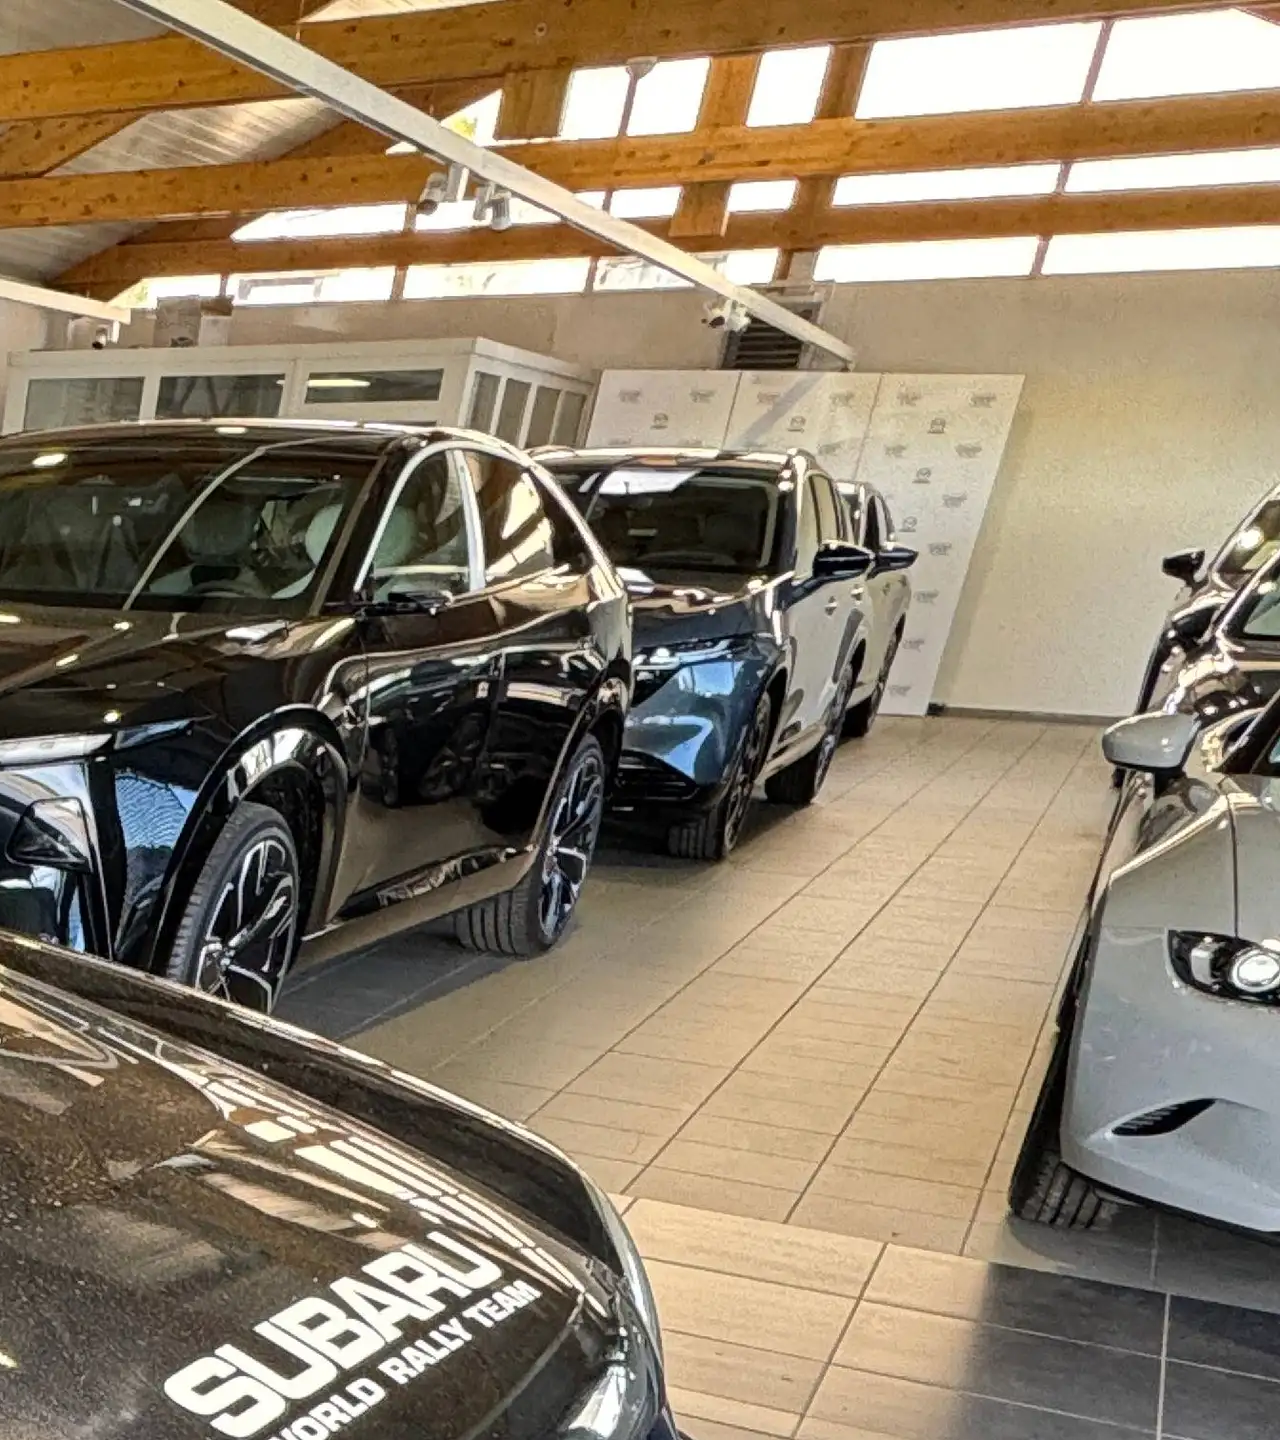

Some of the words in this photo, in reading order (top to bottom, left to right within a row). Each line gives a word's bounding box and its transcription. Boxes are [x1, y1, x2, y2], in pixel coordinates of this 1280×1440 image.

[164, 1231, 503, 1438] SUBARU
[377, 1317, 473, 1385] RALLY
[465, 1280, 542, 1328] TEAM
